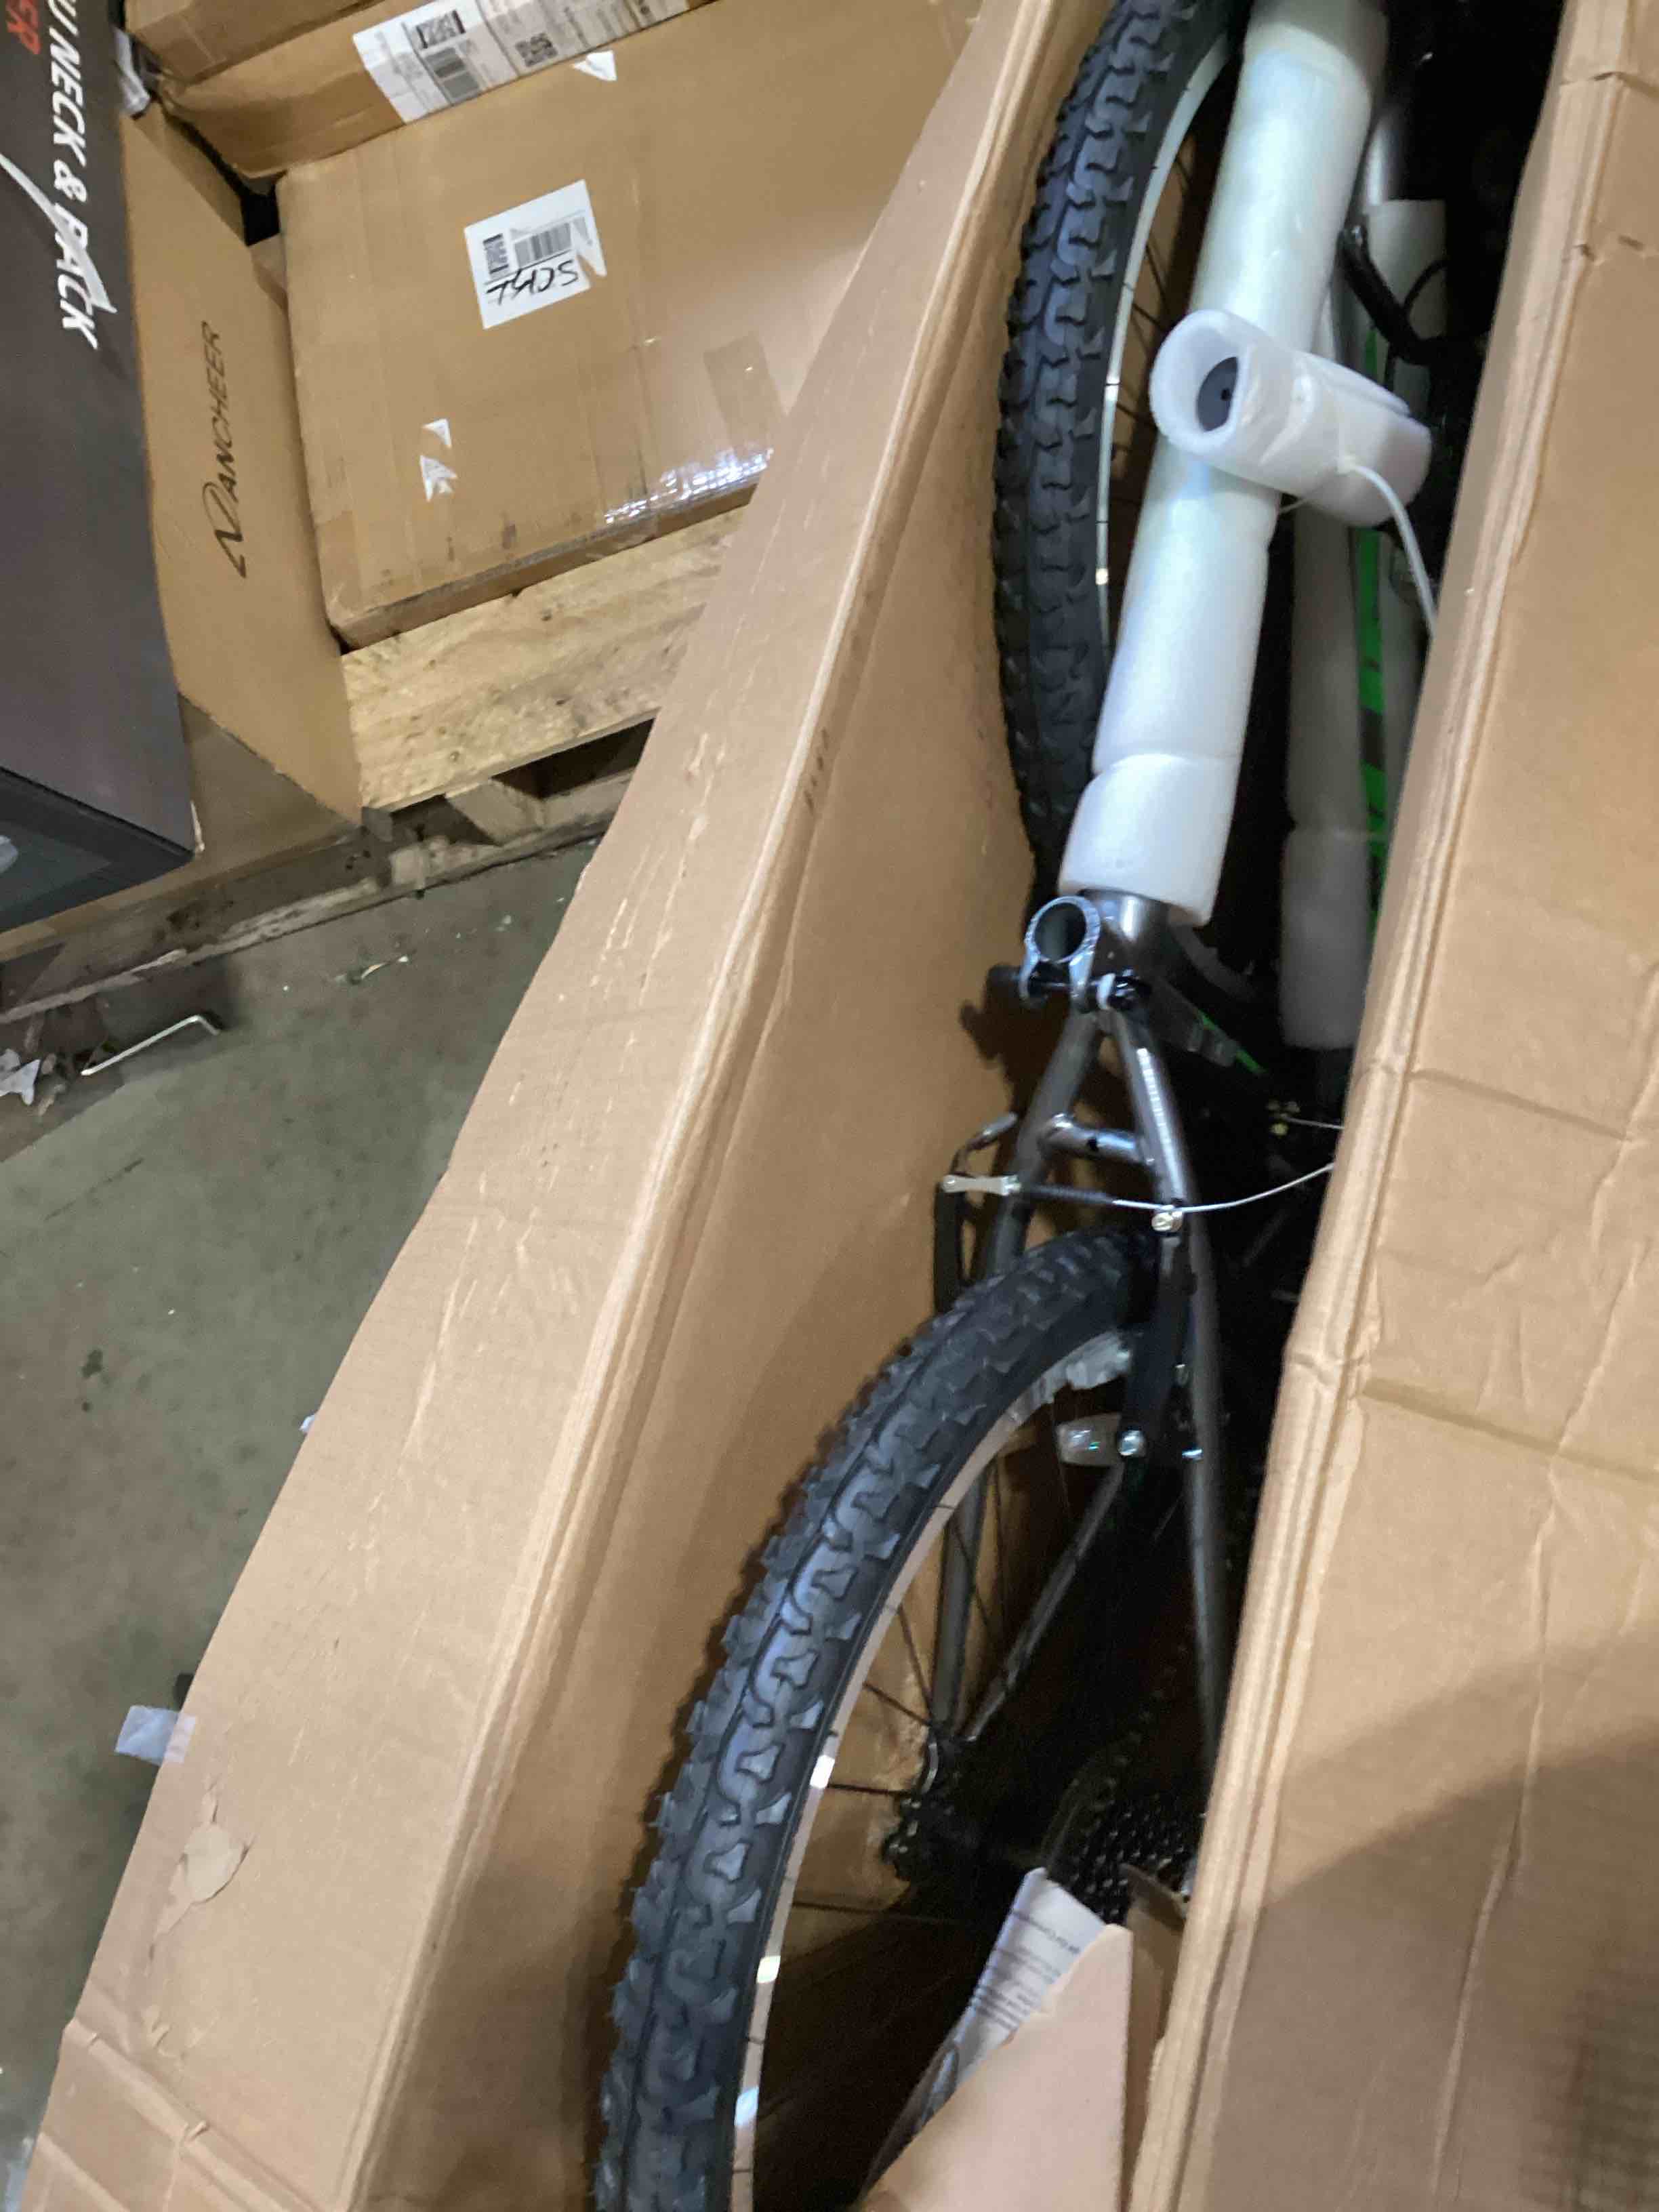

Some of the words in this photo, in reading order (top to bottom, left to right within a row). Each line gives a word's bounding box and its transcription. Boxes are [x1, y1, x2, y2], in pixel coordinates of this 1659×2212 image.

[49, 26, 87, 167] NECK
[54, 159, 87, 203] &
[55, 203, 98, 350] PACK
